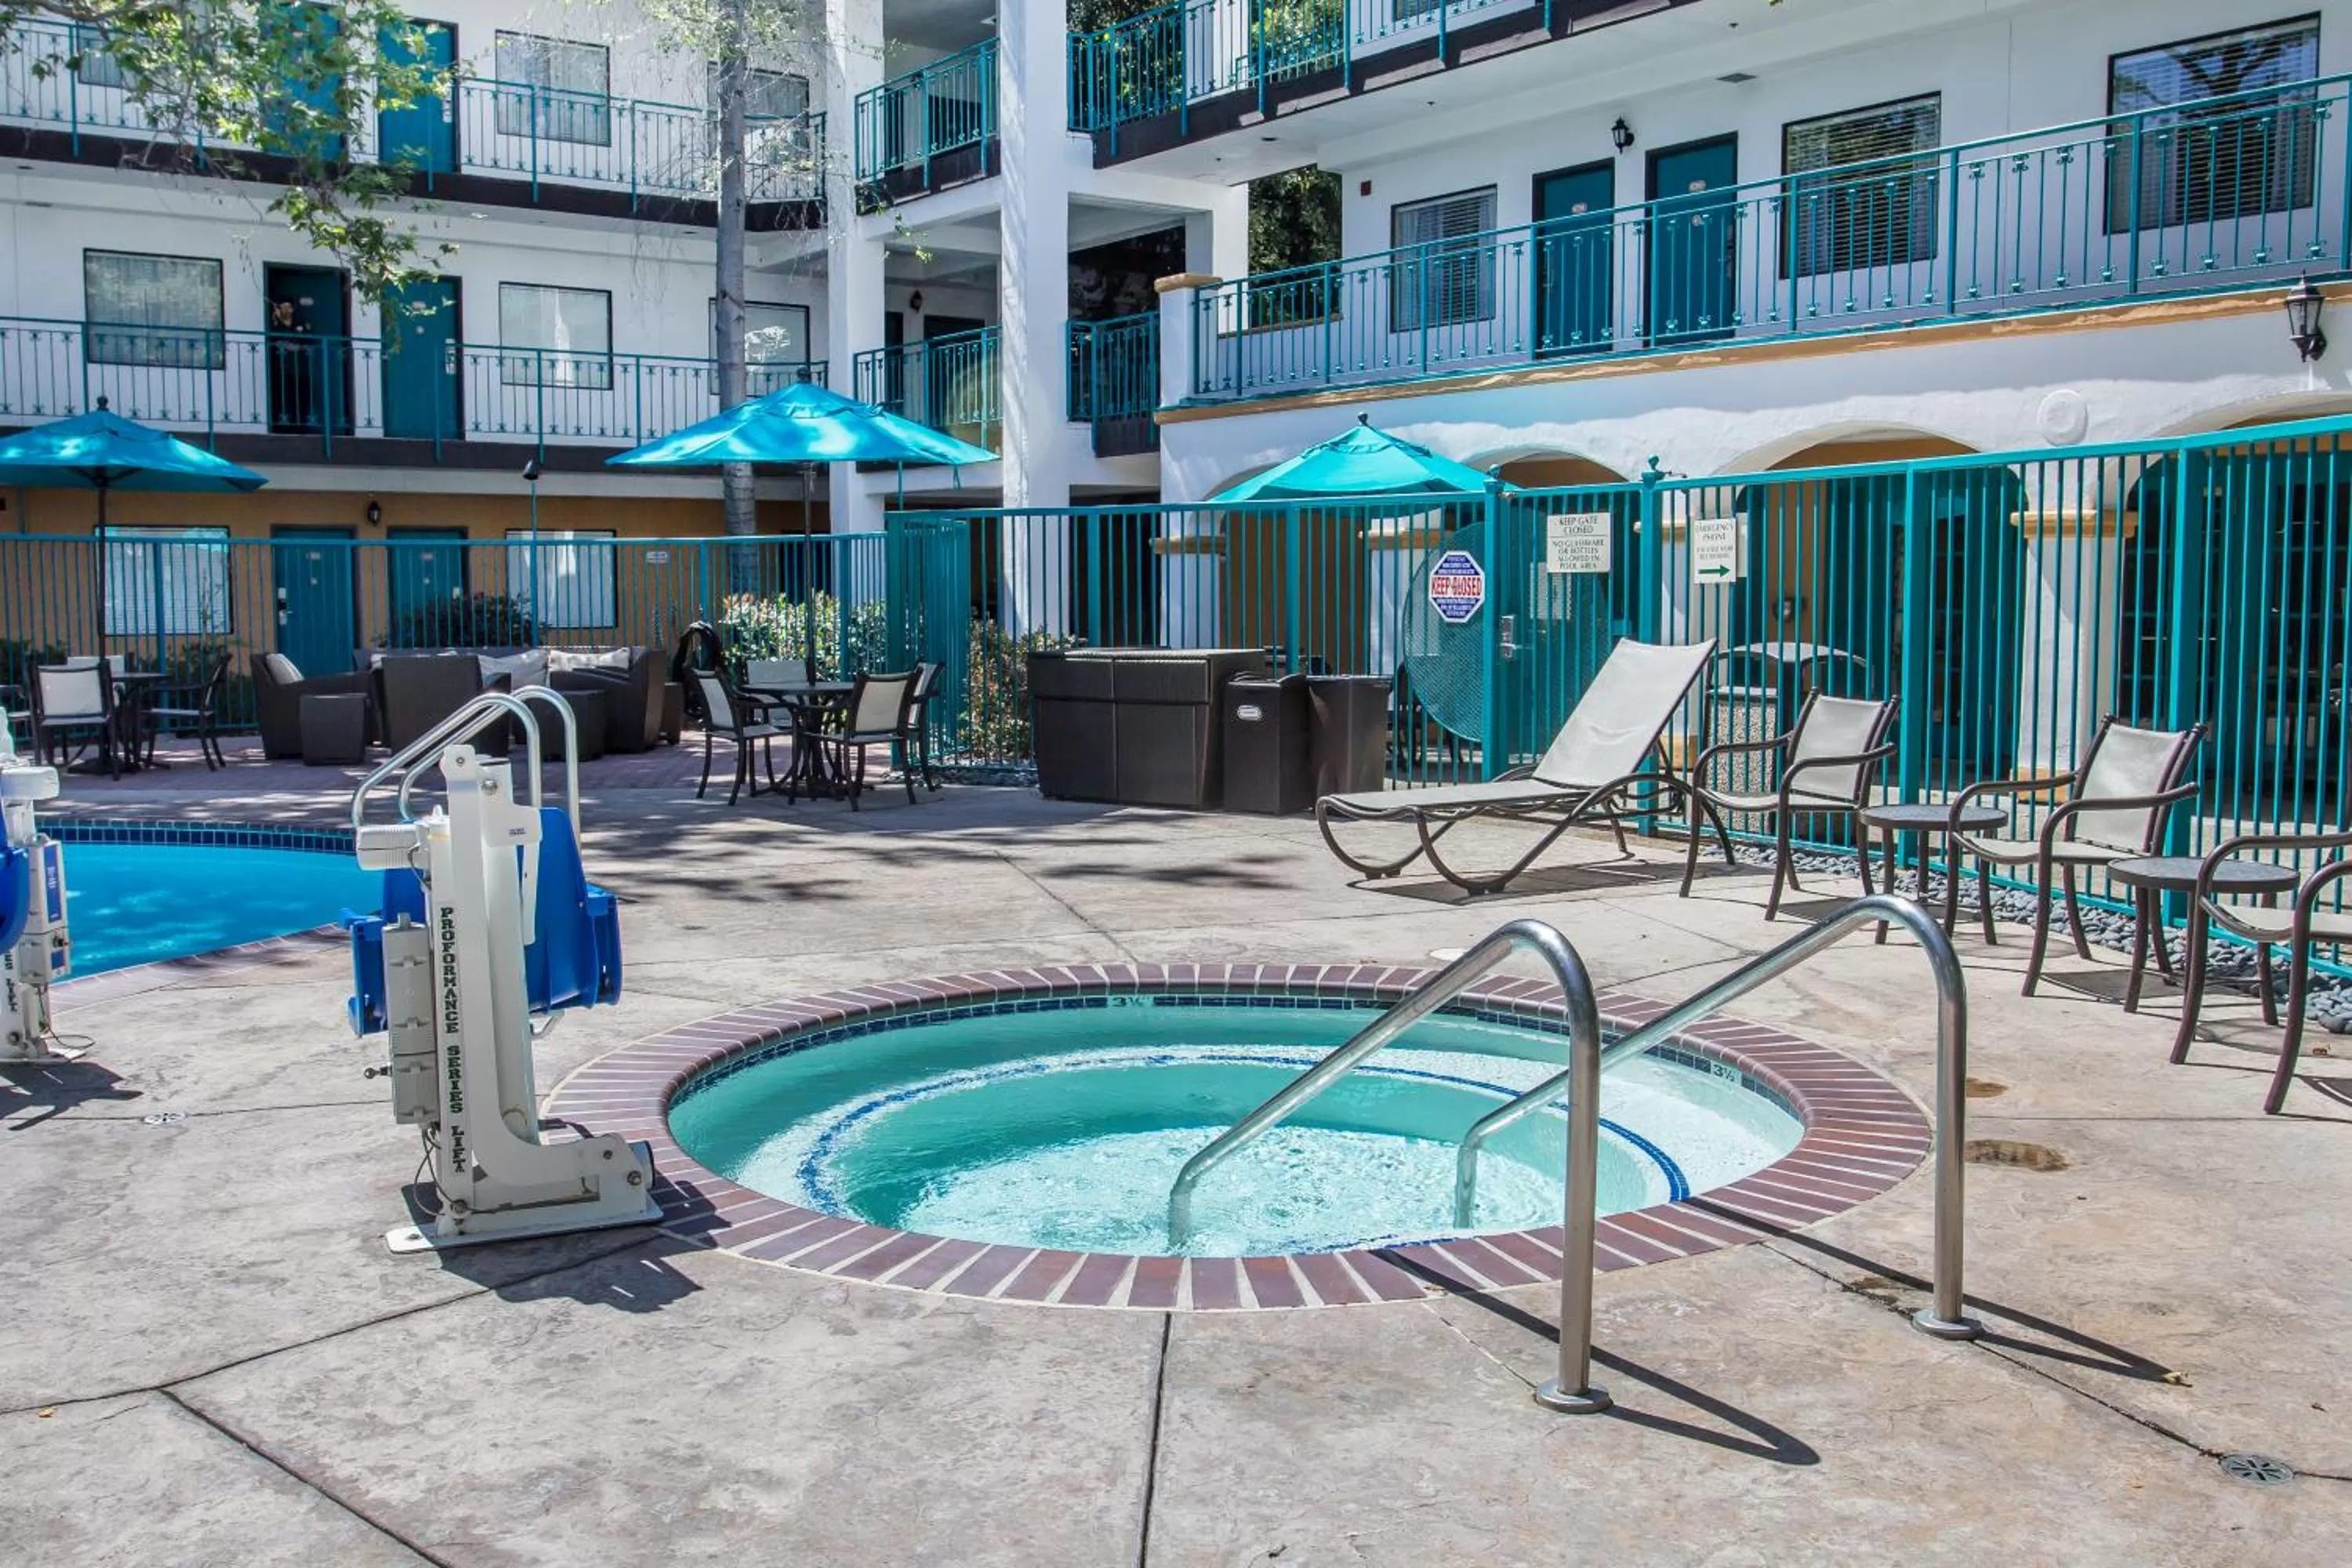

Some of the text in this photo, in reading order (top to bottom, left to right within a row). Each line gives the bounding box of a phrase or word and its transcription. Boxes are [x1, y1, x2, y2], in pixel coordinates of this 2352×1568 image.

[1578, 516, 1598, 524] GATE
[1563, 525, 1594, 534] CLOSED
[1432, 576, 1482, 596] KEEP CLOSED
[441, 907, 466, 1173] PROFORMANCE SERIES LIFT
